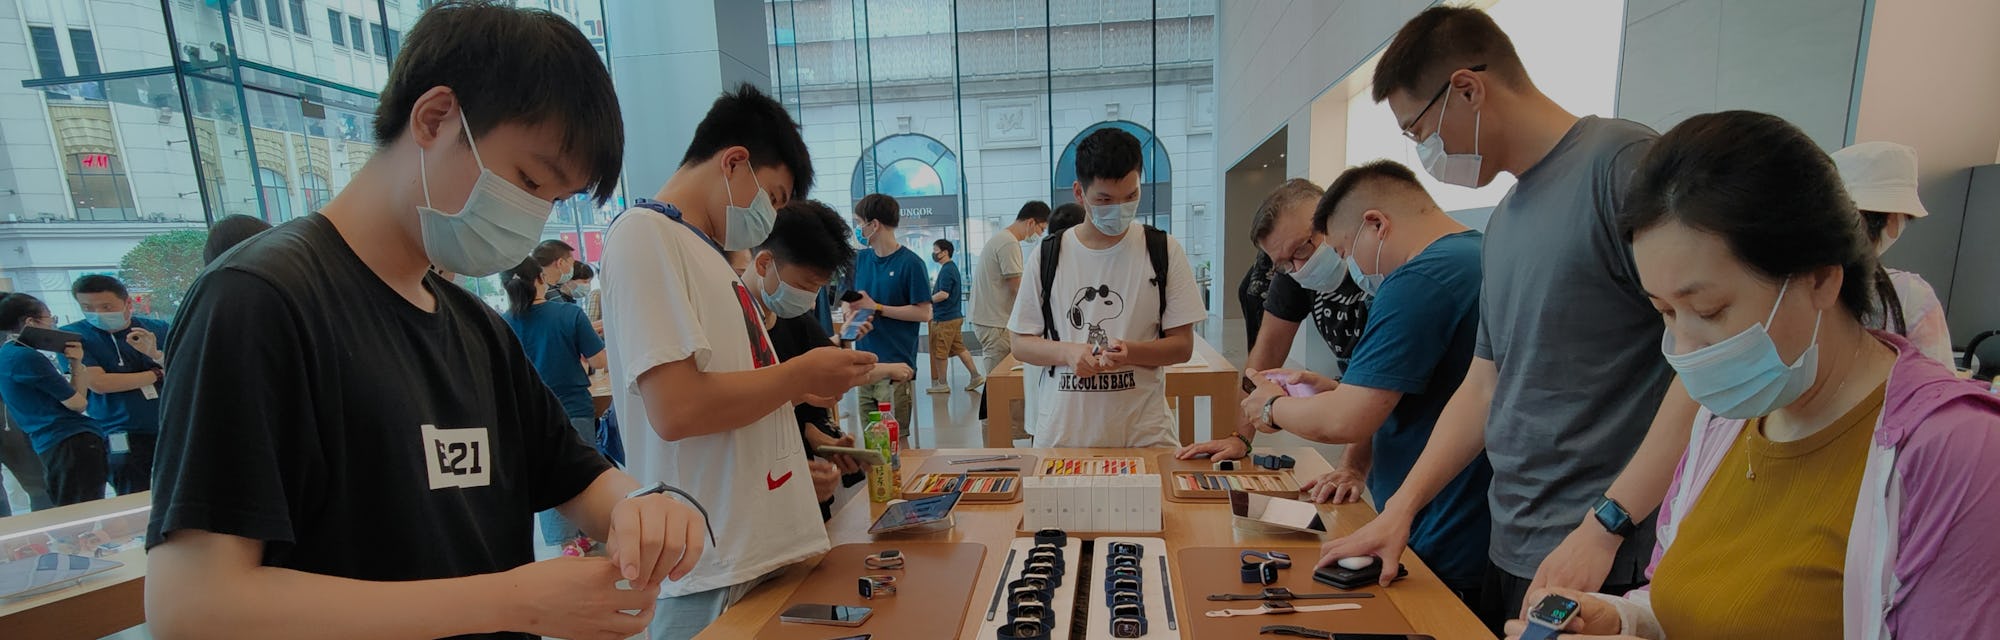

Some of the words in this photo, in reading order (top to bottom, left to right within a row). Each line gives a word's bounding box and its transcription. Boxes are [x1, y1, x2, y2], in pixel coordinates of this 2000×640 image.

[900, 207, 933, 217] UNGOR
[1099, 374, 1109, 389] IS
[1111, 372, 1136, 389] BACK
